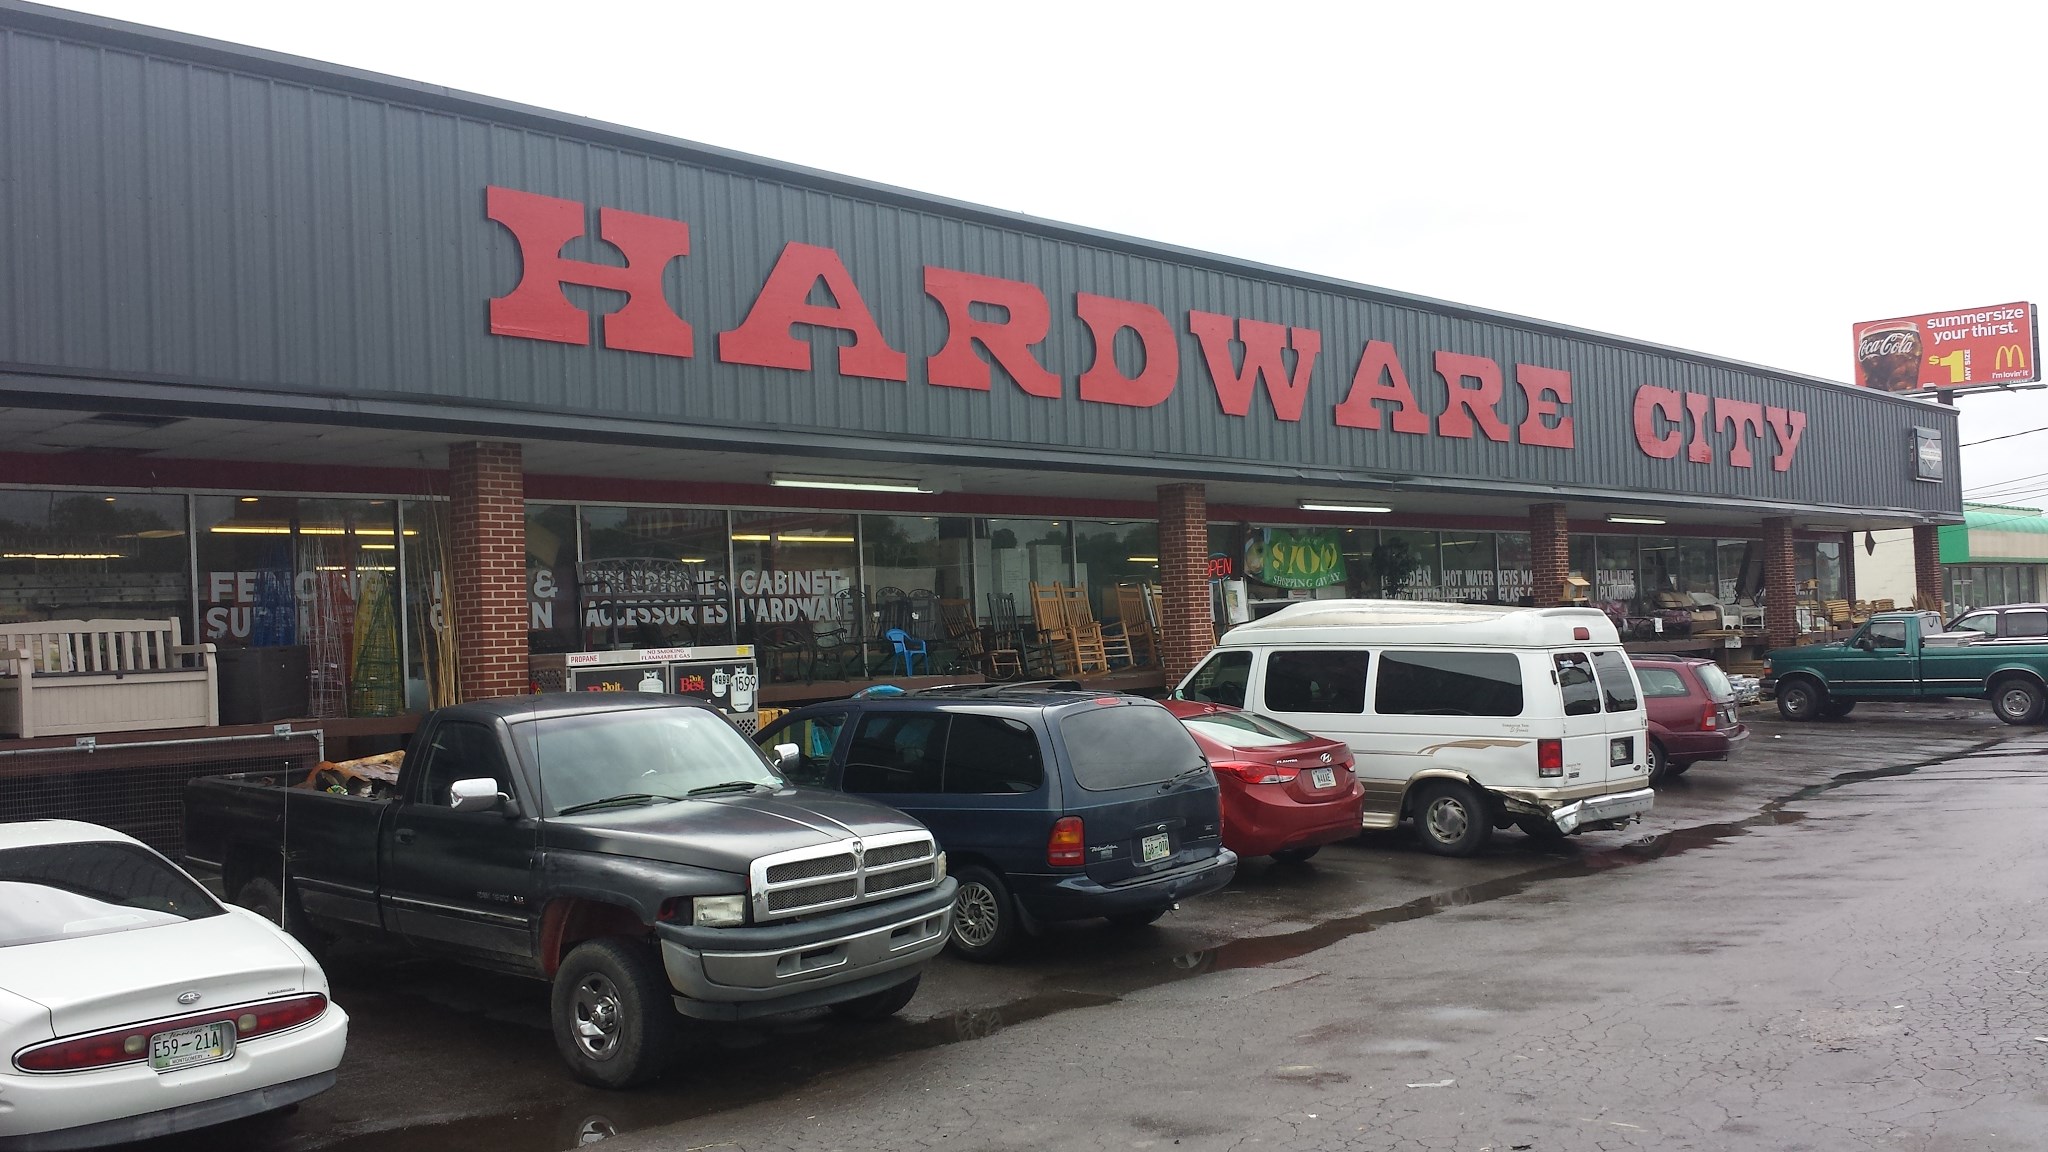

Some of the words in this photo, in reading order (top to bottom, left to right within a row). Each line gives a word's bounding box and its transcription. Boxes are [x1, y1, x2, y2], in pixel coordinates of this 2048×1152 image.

[1926, 306, 2024, 329] summersize
[486, 186, 1575, 449] HARDWARE
[1634, 384, 1808, 473] CITY
[1934, 328, 1967, 345] your
[1971, 321, 2019, 338] thirst.
[1208, 557, 1232, 578] PEN
[1443, 569, 1462, 586] HOT
[1465, 569, 1495, 586] WATER
[1499, 569, 1519, 586] KEYS
[740, 569, 840, 596] CABINET
[586, 598, 728, 627] ACCESSORES
[570, 655, 598, 663] PROPANE
[680, 677, 706, 692] Best
[154, 1031, 219, 1059] E59-21A
[172, 1054, 203, 1064] MONTGOMERY
